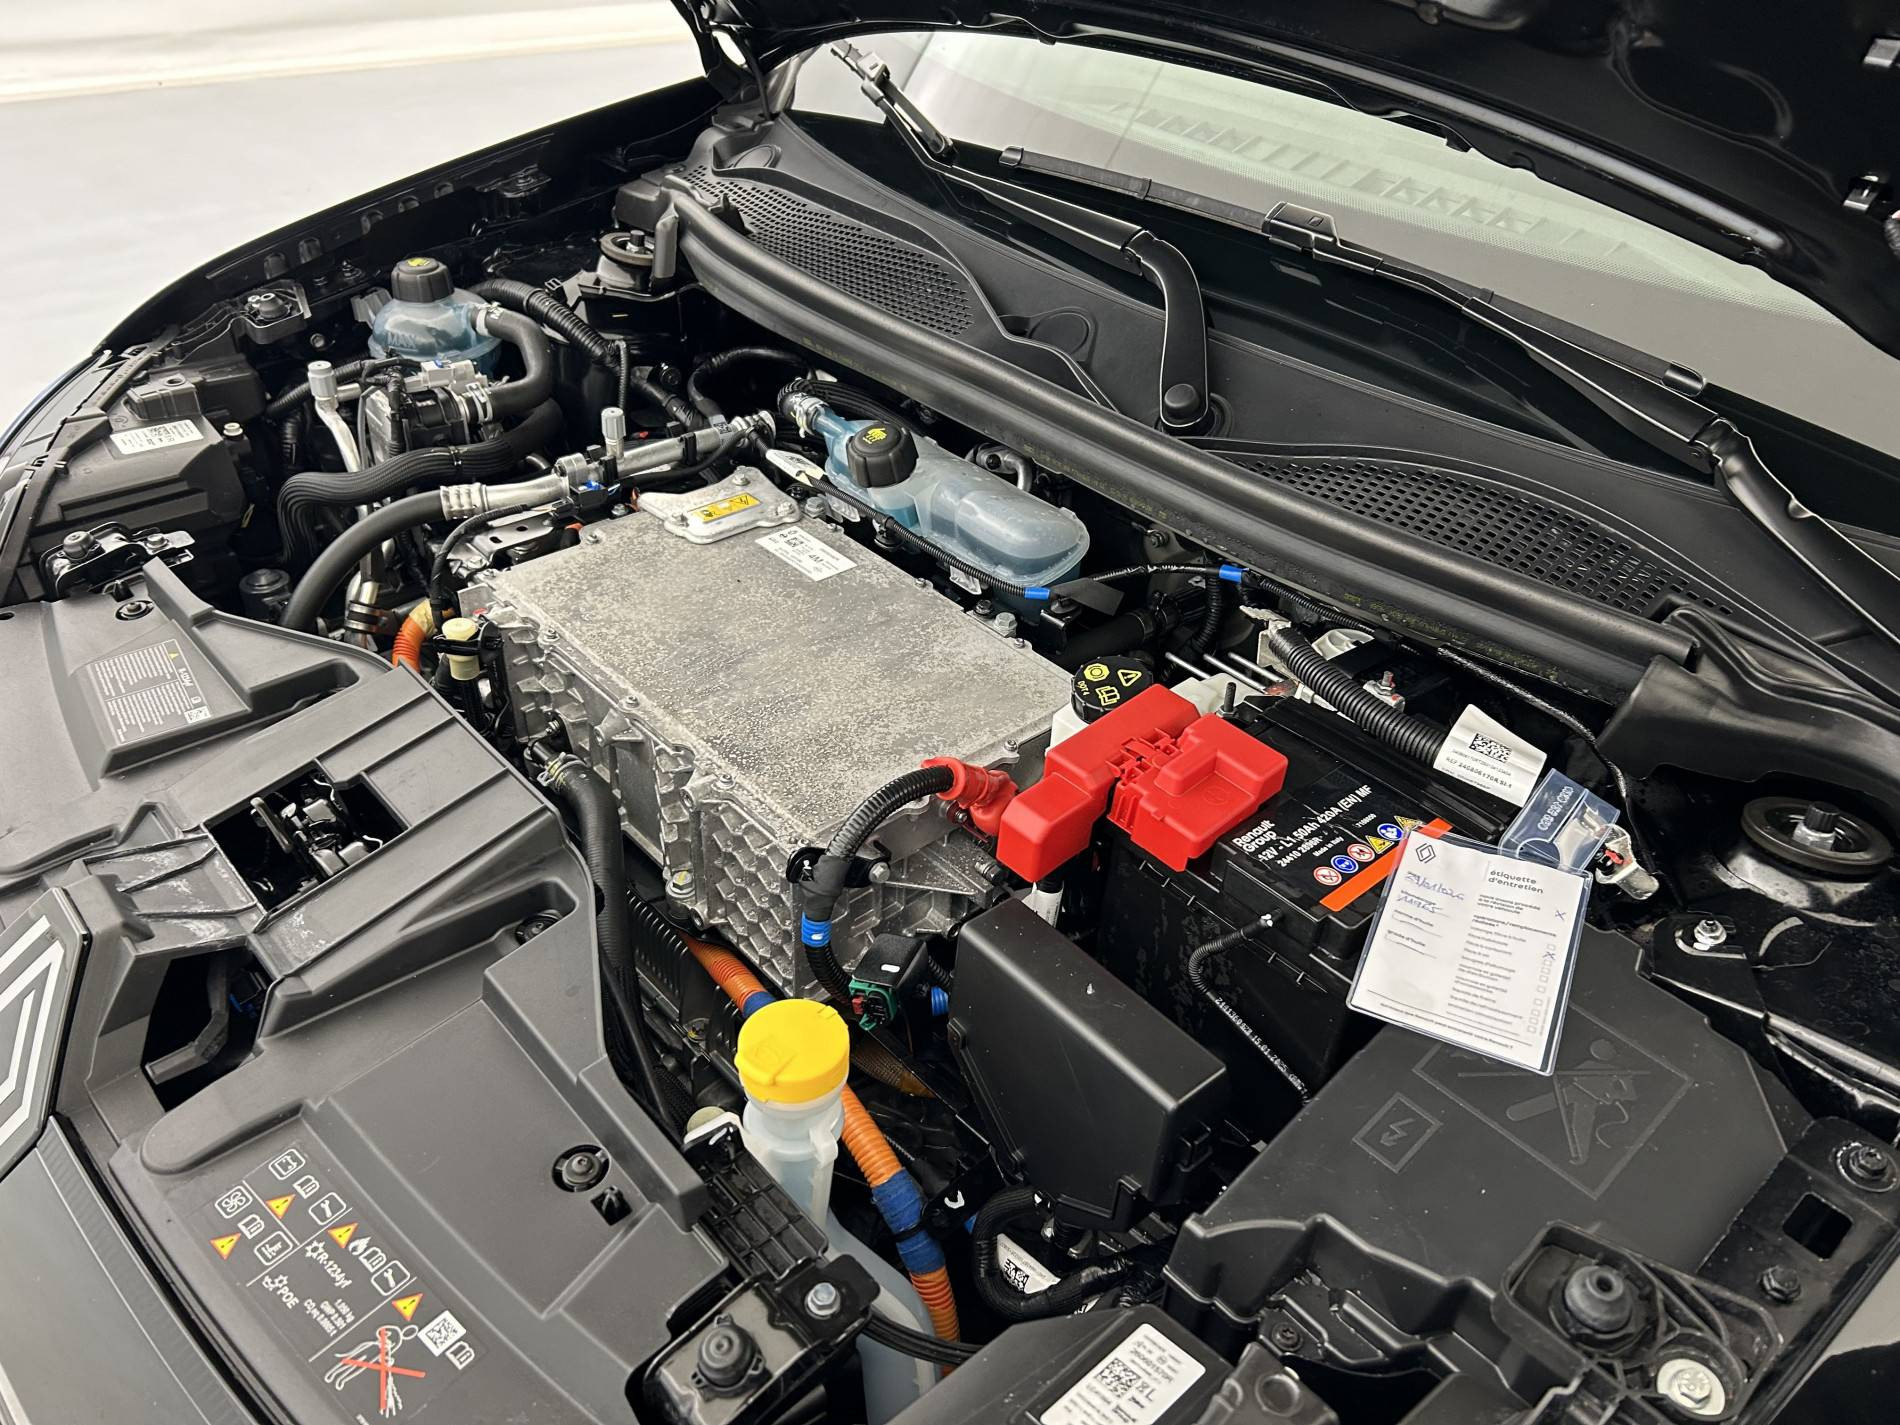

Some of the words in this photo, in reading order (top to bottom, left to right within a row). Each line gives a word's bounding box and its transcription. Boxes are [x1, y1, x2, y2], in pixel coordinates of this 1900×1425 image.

[1232, 820, 1275, 847] Renault
[1258, 846, 1278, 862] 12V
[1318, 806, 1343, 824] 420A
[1337, 793, 1362, 812] (EN)
[1358, 784, 1373, 798] MF
[1242, 830, 1277, 852] Group
[1313, 848, 1324, 857] Made
[1330, 836, 1344, 846] Italy
[1489, 877, 1544, 894] d'entretien
[316, 1252, 352, 1288] R-1234yf
[277, 1286, 299, 1309] POE
